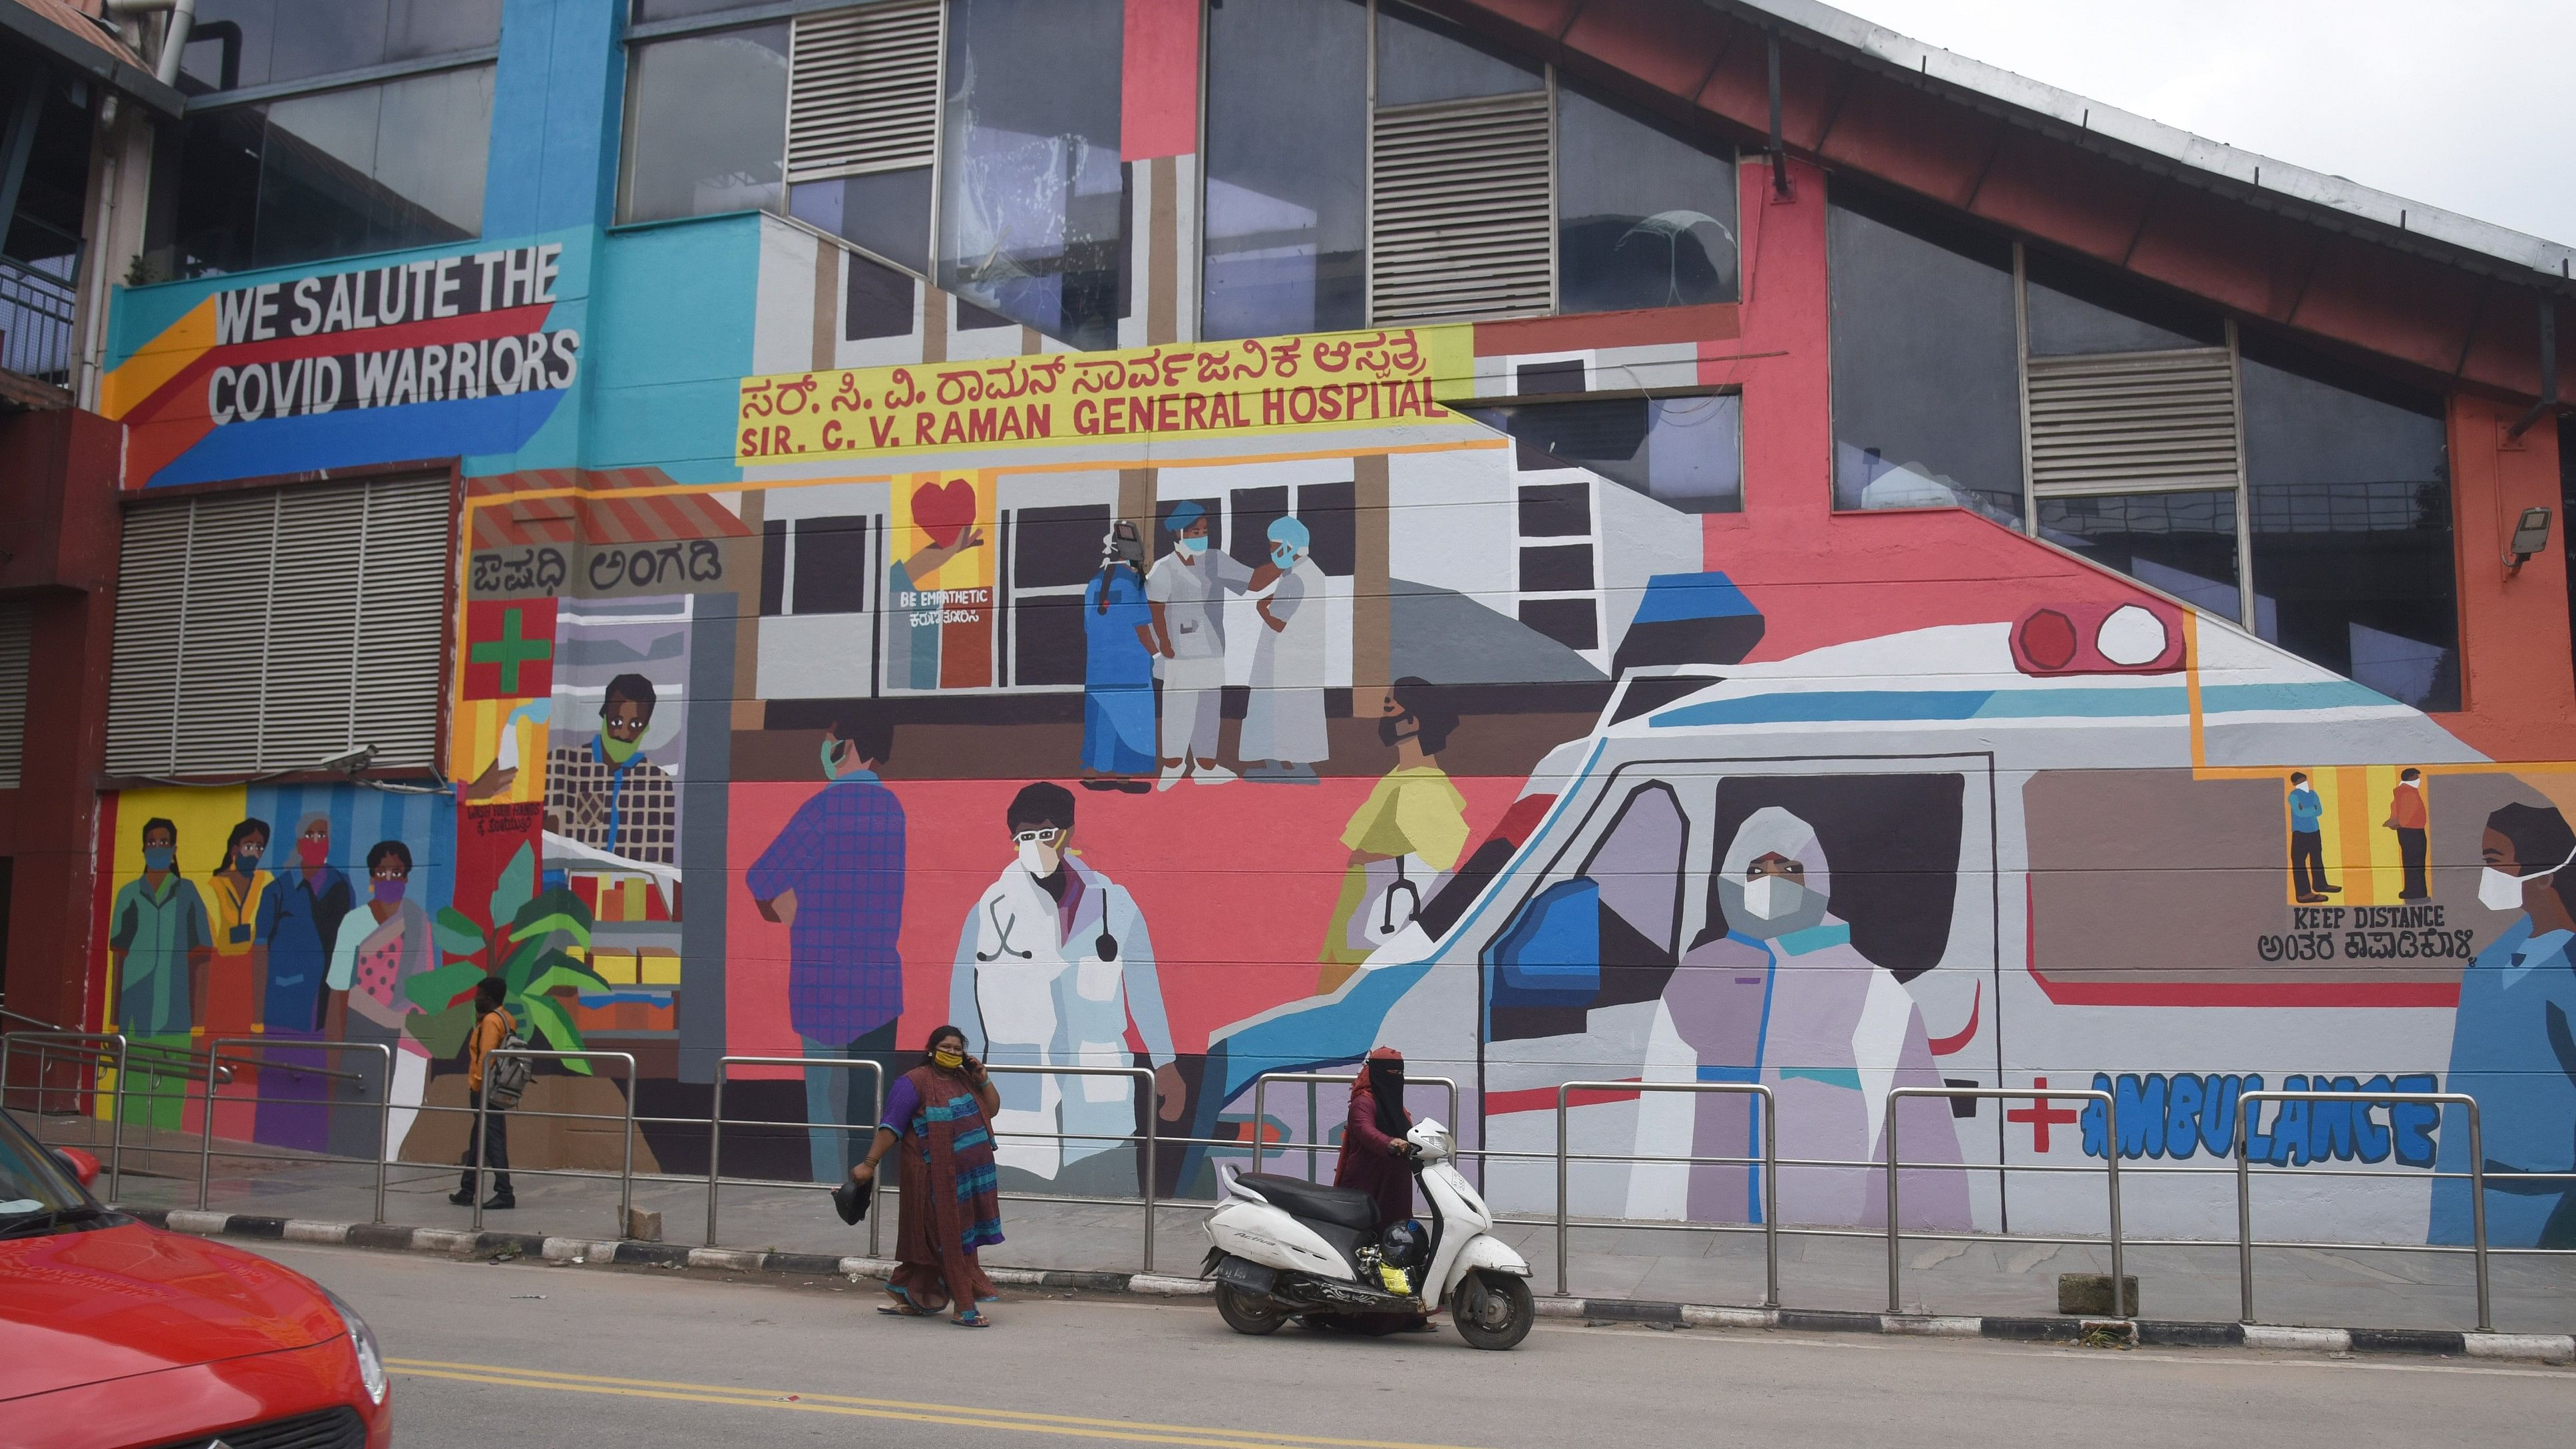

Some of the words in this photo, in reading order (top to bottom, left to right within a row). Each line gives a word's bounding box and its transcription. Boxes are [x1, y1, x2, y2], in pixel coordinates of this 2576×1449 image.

[216, 284, 279, 345] WE
[291, 260, 461, 337] SALUTE
[474, 243, 563, 312] THE
[208, 357, 342, 426] COVID
[356, 329, 580, 409] WARRIORS
[936, 355, 1065, 405] ರಾಮನ್
[741, 425, 806, 457] SIR.
[822, 419, 855, 451] C.
[869, 415, 900, 447] V.
[916, 404, 1051, 445] RAMAN
[1073, 391, 1250, 435] GENERAL
[1263, 377, 1449, 425] HOSPITAL
[588, 540, 723, 591] ಅಂಗಡಿ
[900, 591, 917, 608] BE
[921, 590, 988, 606] EMPATHETIC
[2293, 907, 2346, 930] KEEP
[2354, 905, 2445, 929] DISTANCE
[2257, 931, 2334, 962] ಅಂತರ
[2080, 1072, 2441, 1169] AMBULANCE
[1234, 1232, 1276, 1246] Activa
